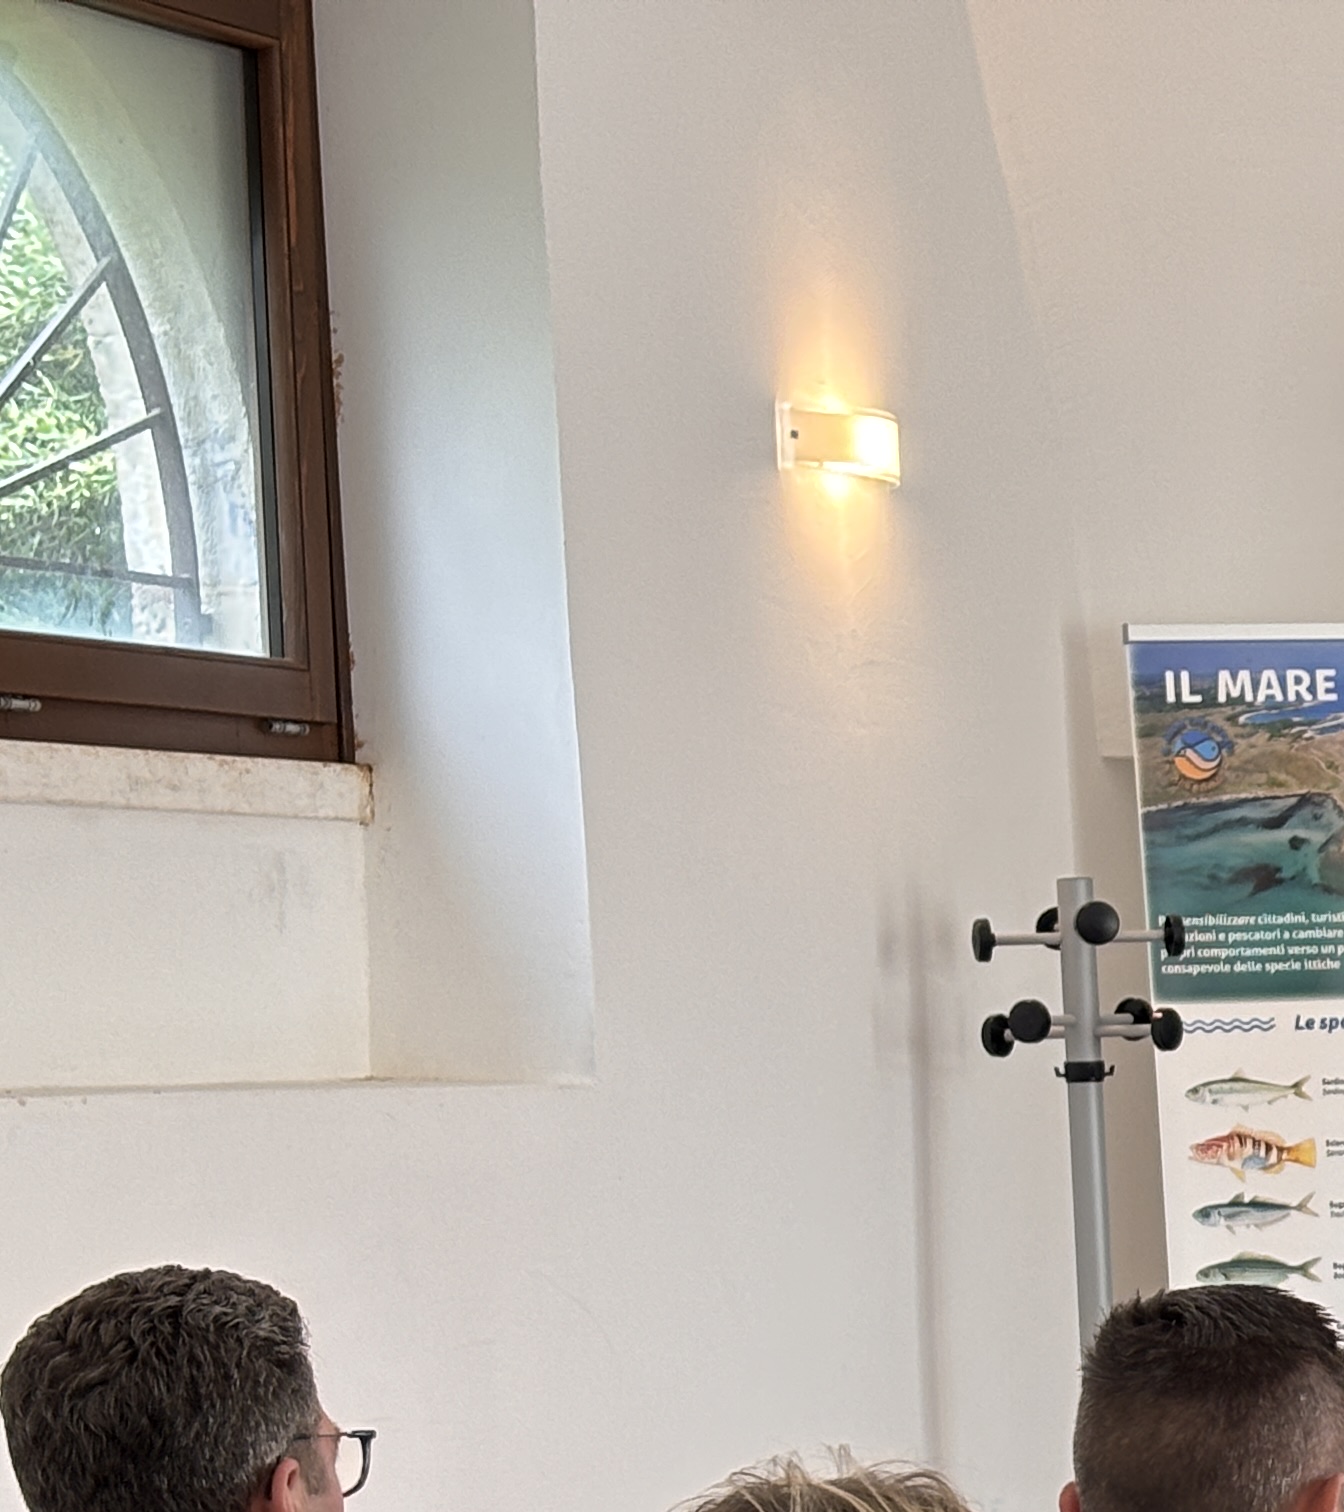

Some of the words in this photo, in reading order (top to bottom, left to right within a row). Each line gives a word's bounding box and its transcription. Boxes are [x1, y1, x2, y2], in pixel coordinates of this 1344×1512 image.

[1165, 669, 1203, 704] IL
[1217, 668, 1338, 703] MARE
[1227, 928, 1280, 944] pescatori
[1292, 926, 1343, 939] cambiare
[1198, 944, 1284, 959] comportamenti
[1287, 945, 1318, 954] verso
[1320, 944, 1335, 954] un
[1162, 961, 1230, 976] consapevole
[1233, 960, 1262, 972] delle
[1264, 958, 1301, 974] specie
[1304, 957, 1340, 970] ittiche
[1294, 1014, 1314, 1030] Le
